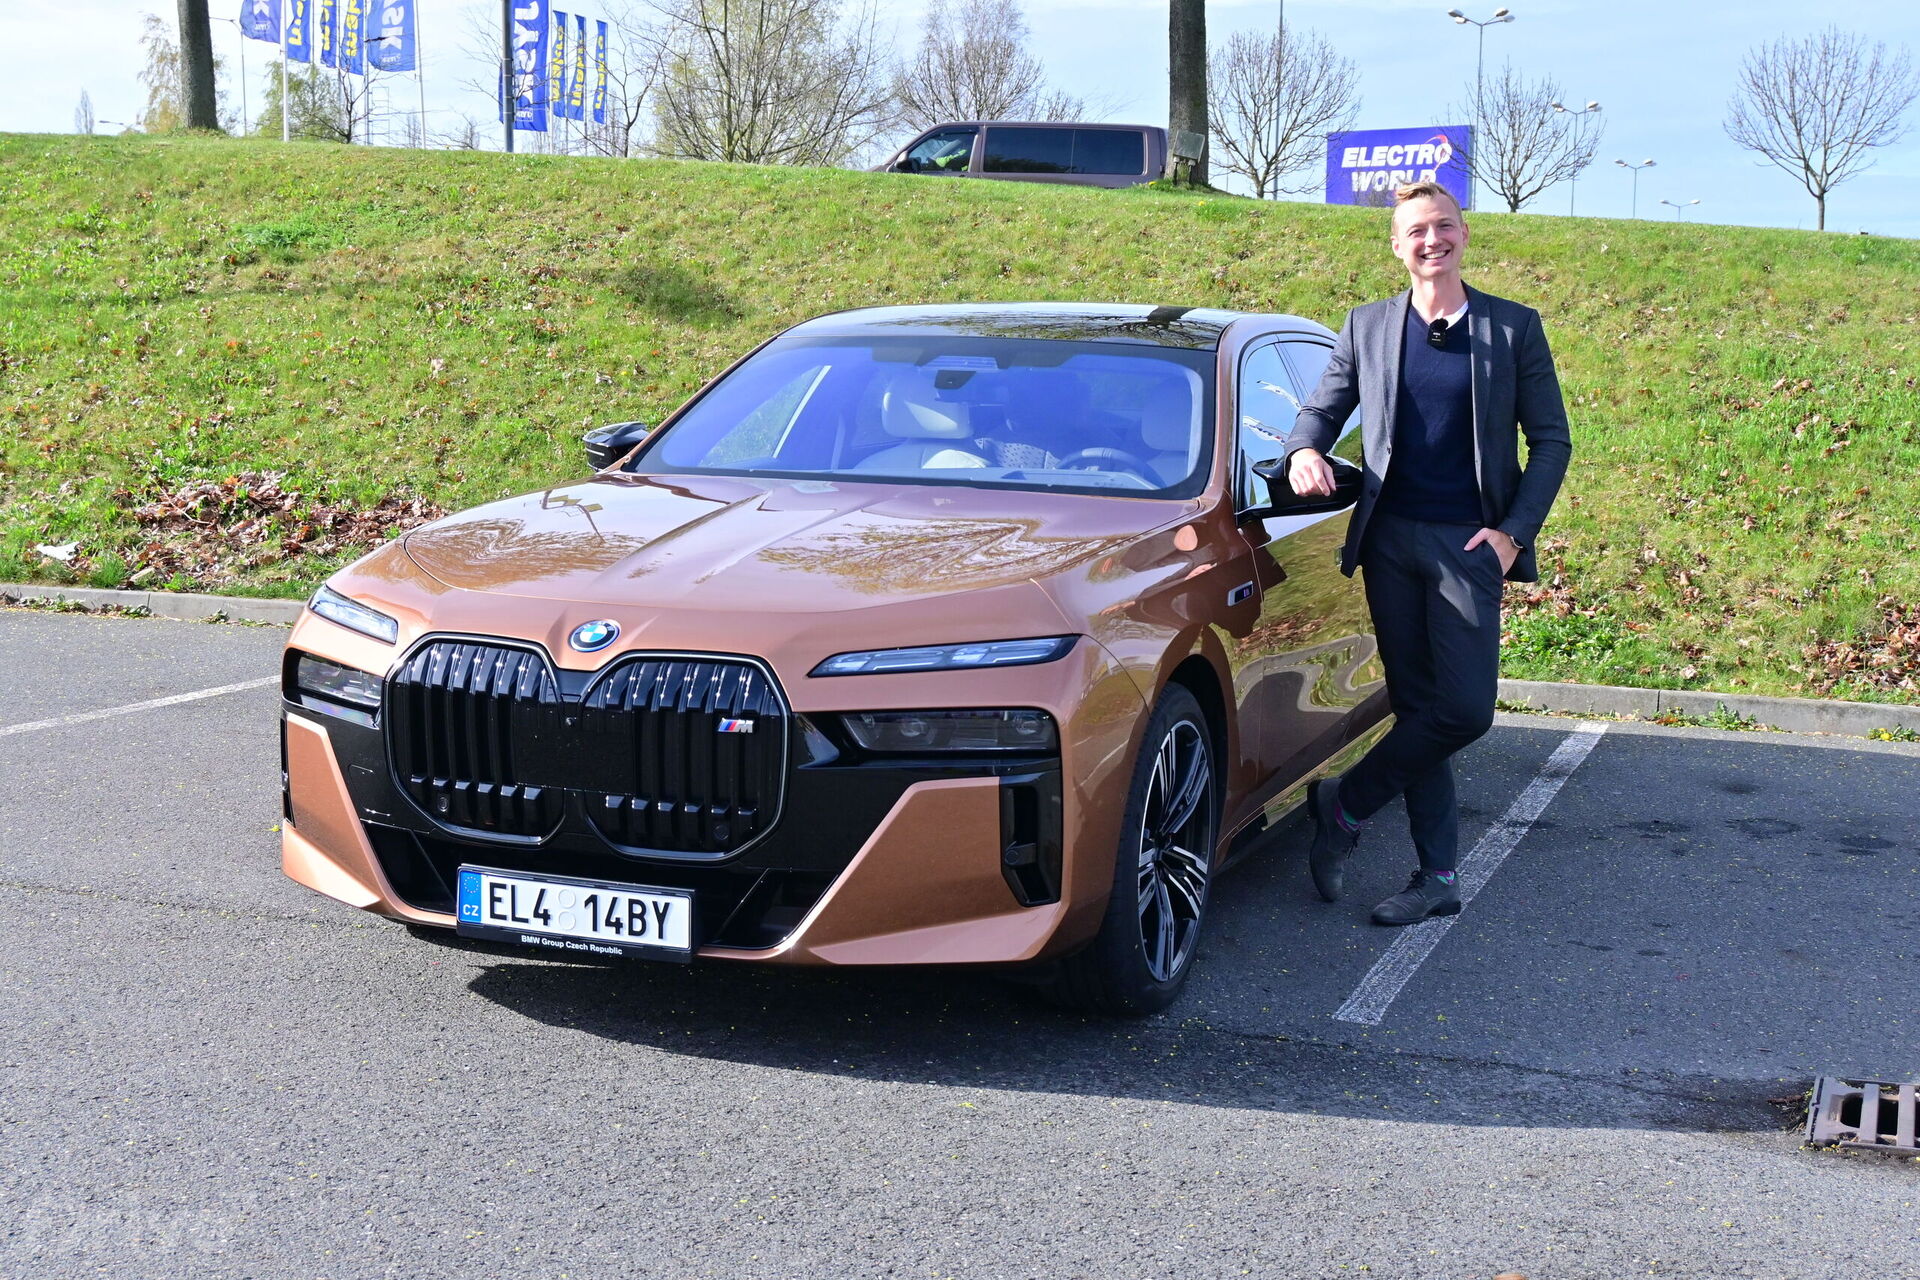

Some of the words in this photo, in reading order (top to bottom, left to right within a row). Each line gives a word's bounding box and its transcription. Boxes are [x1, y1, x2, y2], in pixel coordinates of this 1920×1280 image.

[1341, 143, 1452, 168] ELECTRO
[462, 904, 480, 917] CZ
[489, 882, 551, 926] EL4
[584, 894, 671, 940] 14BY
[521, 935, 540, 945] BMW
[541, 937, 565, 949] Group
[565, 941, 589, 951] Czech
[589, 944, 623, 955] Republic
